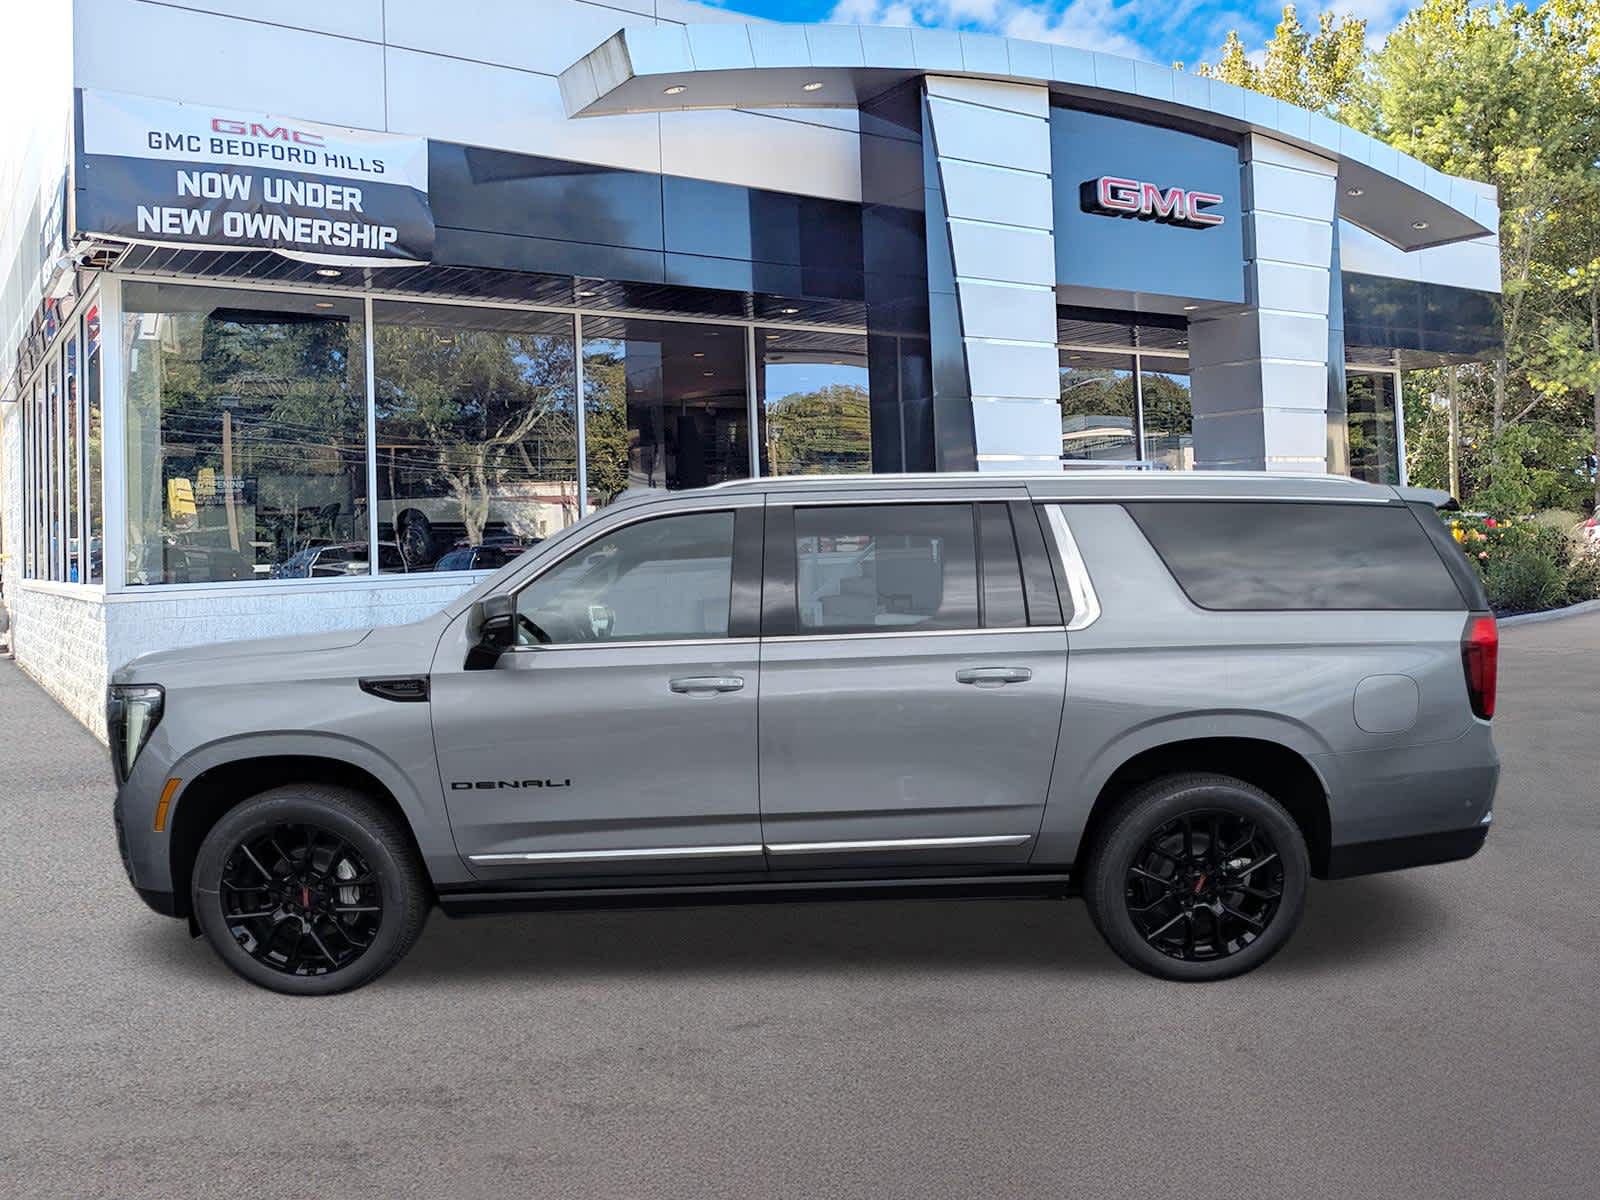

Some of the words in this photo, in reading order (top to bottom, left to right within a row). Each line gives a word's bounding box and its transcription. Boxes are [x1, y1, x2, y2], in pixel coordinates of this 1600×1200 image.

[148, 131, 201, 152] GMC
[210, 138, 316, 165] BEDFORD
[324, 152, 385, 174] HILLS
[211, 118, 325, 148] GMC
[176, 170, 252, 200] NOW
[263, 177, 363, 213] UNDER
[1098, 176, 1224, 224] GMC
[137, 205, 211, 236] NEW
[223, 211, 398, 250] OWNERSHIP
[451, 779, 571, 790] DENALI
